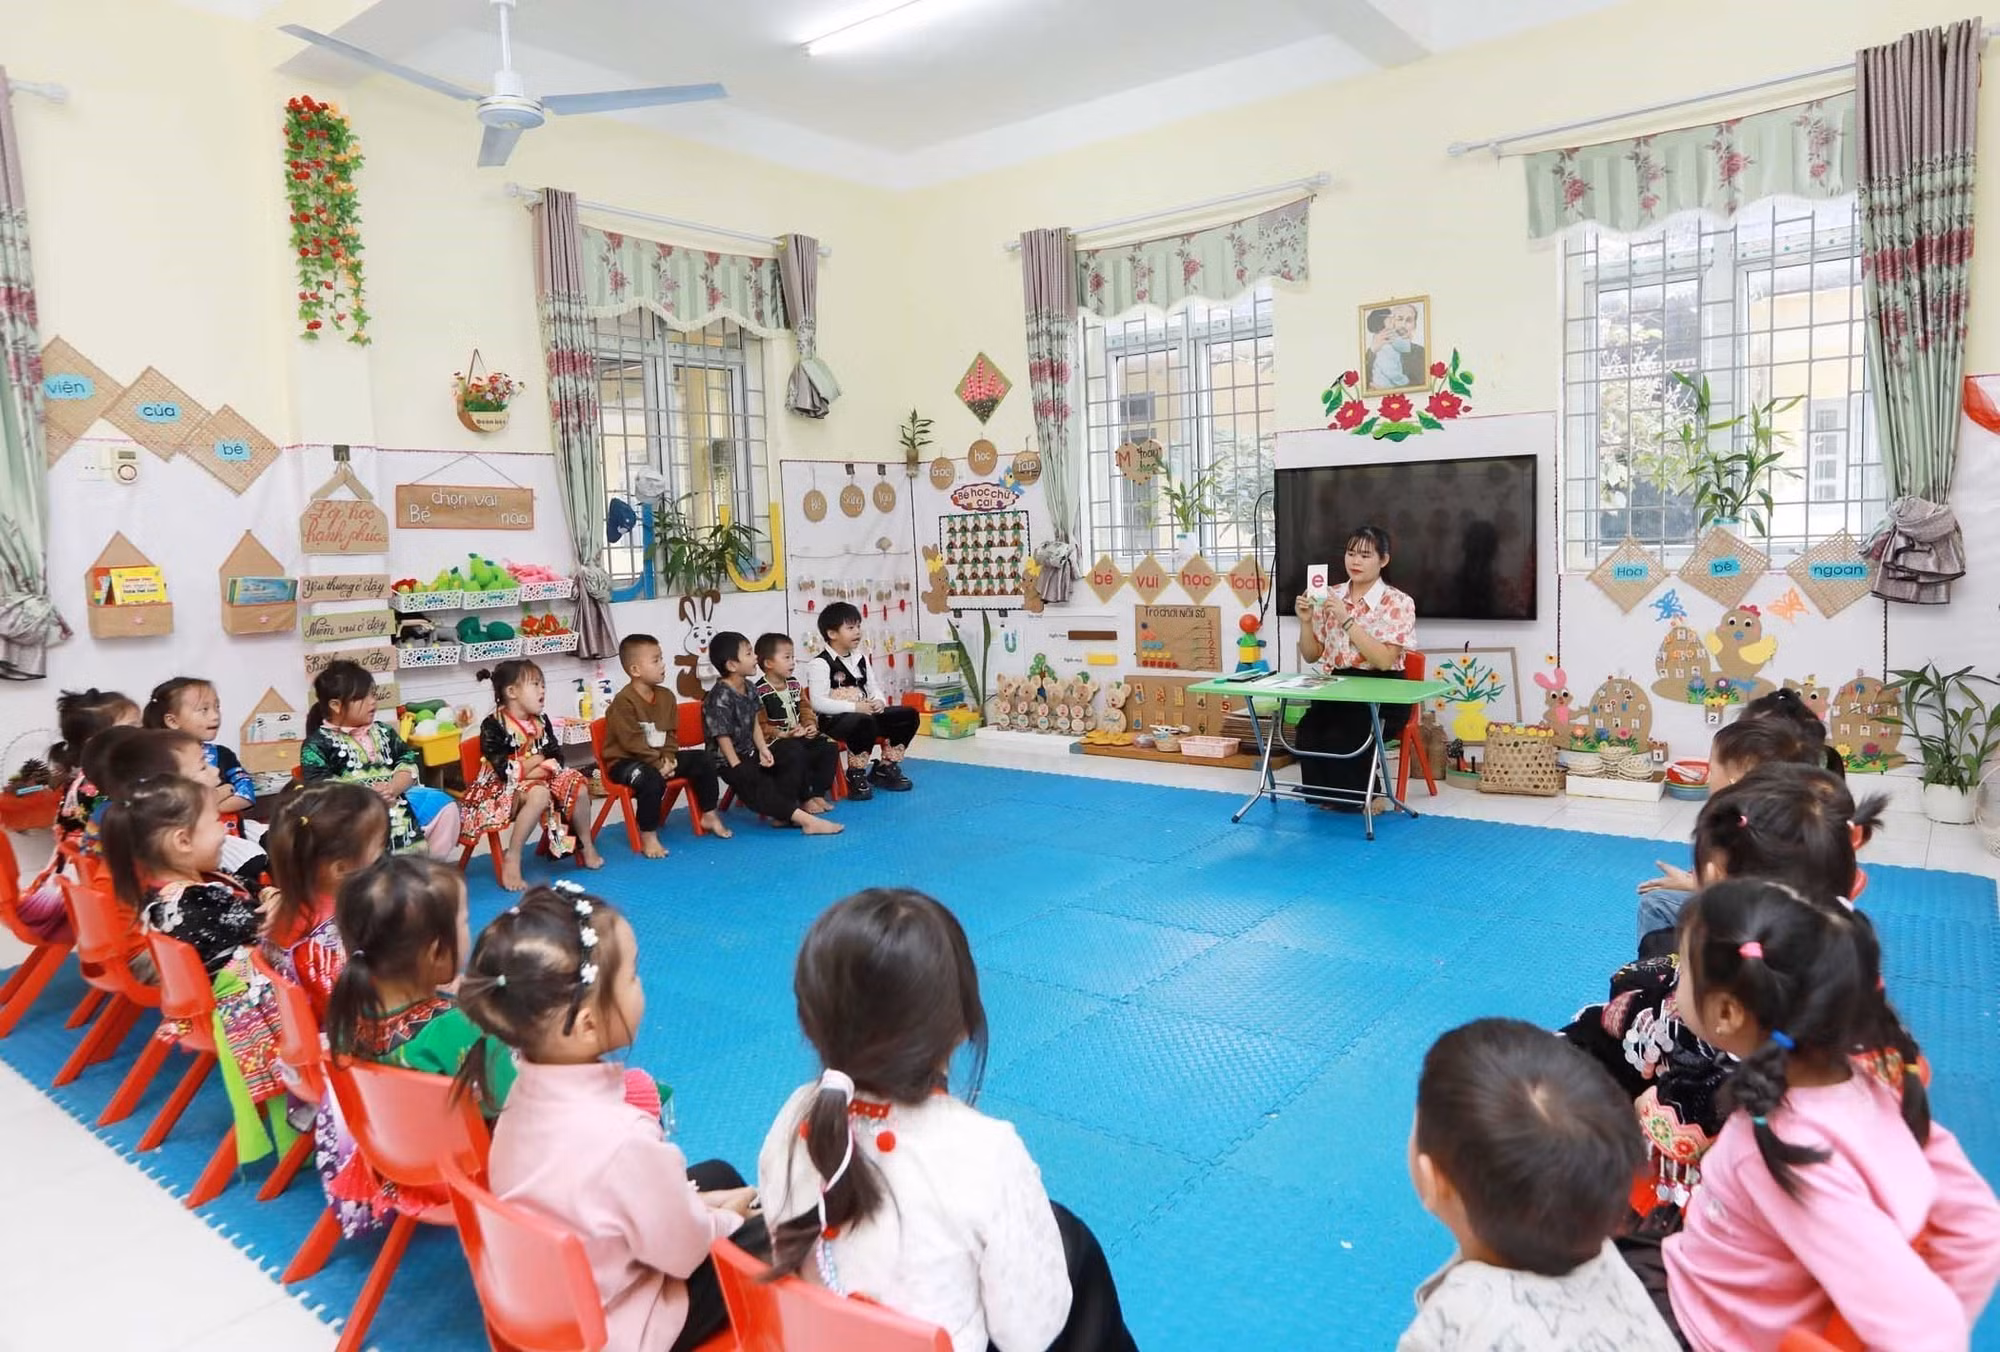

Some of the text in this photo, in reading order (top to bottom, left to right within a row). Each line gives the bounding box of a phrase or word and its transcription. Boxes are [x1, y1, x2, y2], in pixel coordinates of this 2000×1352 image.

[44, 381, 244, 456] viện của bé
[410, 503, 431, 523] Bé
[431, 487, 467, 509] chọn
[474, 494, 498, 507] vai
[1713, 560, 1732, 574] bé
[1813, 565, 1864, 578] ngoan
[1093, 570, 1114, 585] bé
[1136, 575, 1159, 588] vui
[1181, 571, 1212, 590] học
[1311, 574, 1325, 588] e
[1222, 701, 1230, 712] 5
[1709, 715, 1718, 723] 2
